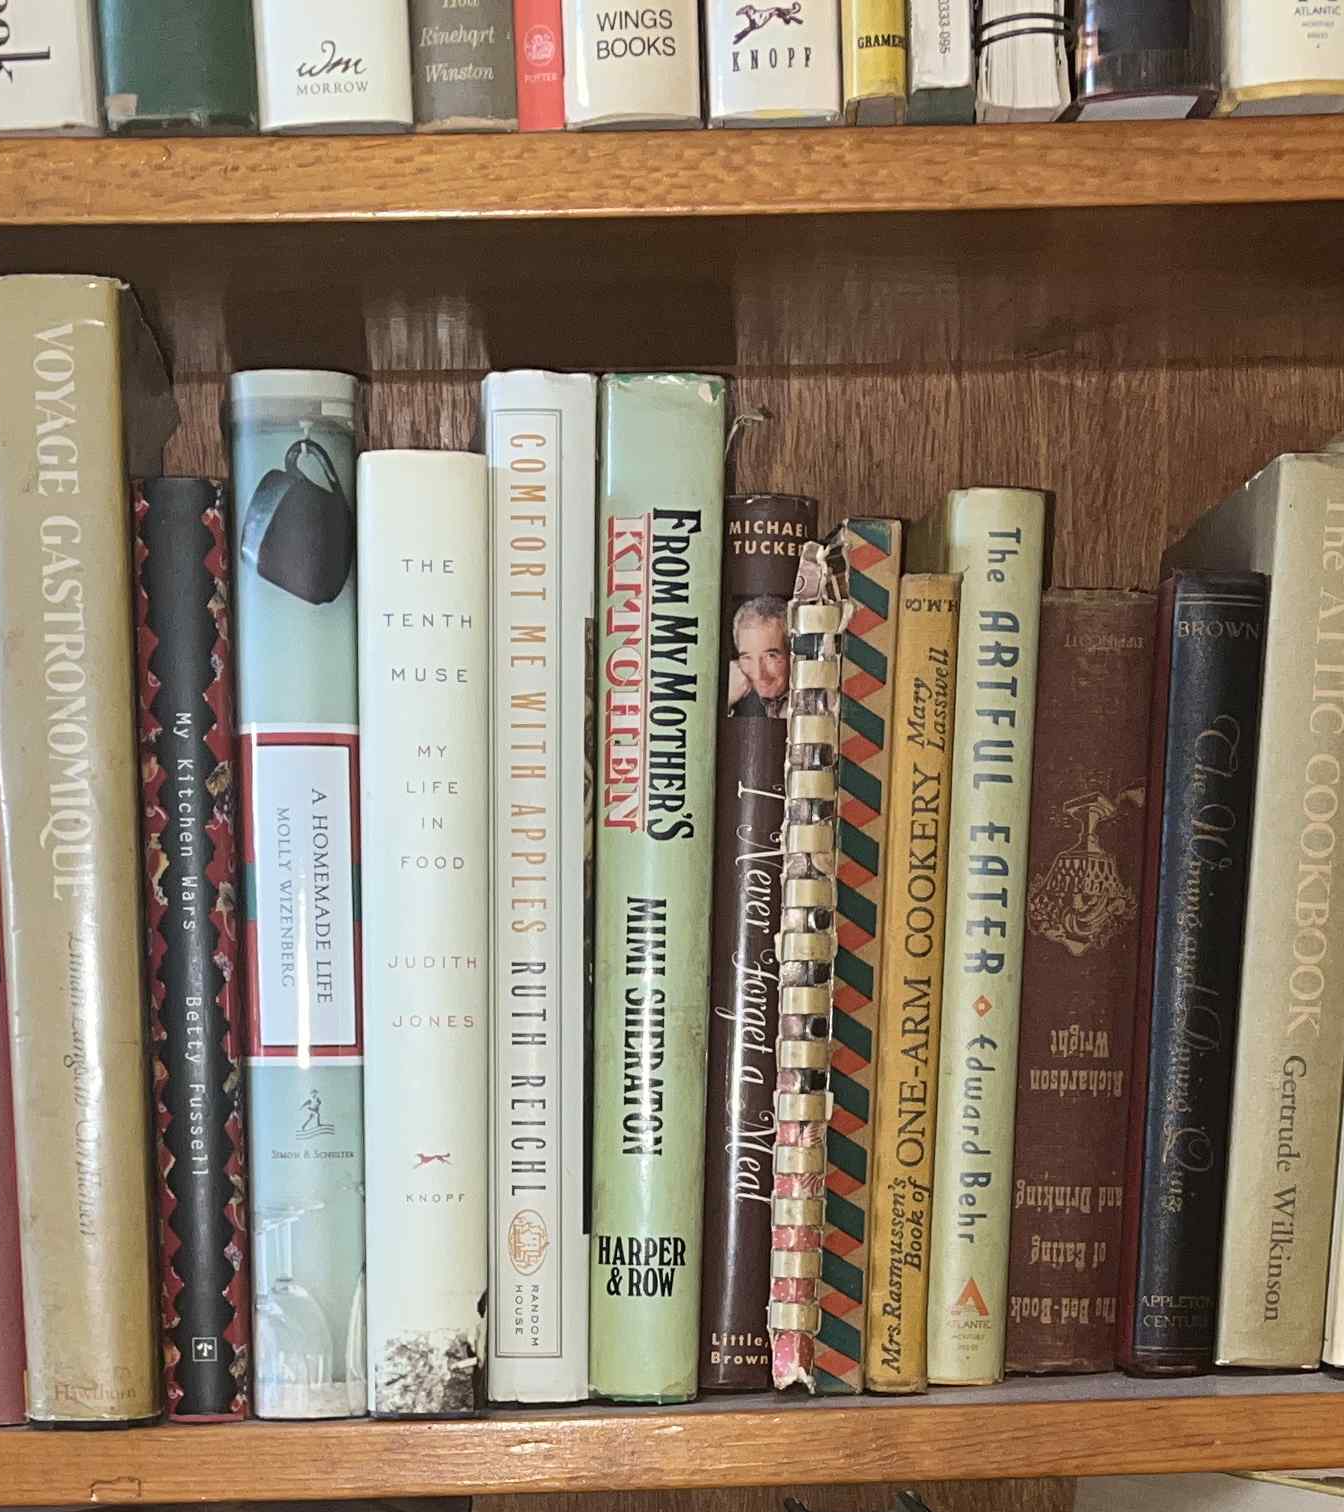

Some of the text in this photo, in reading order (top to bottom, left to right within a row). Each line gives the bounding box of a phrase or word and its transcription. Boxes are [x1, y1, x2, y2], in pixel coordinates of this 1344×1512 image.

[598, 10, 674, 32] WINGS
[419, 26, 496, 48] Rinehart
[596, 36, 677, 60] BOOKS
[731, 46, 813, 73] KNOPF
[424, 61, 496, 84] Winston
[296, 80, 369, 97] MORROW
[401, 558, 455, 574] THE
[382, 612, 473, 631] TENTH
[391, 667, 470, 684] MUSE
[645, 506, 703, 842] FROM MY MOTHER'S
[964, 527, 1023, 977] The ARTFUL EATER
[173, 711, 201, 932] My Kitchen Wars
[508, 432, 549, 1199] COMFORT ME WITH APPLES RUTH REICHL
[387, 954, 478, 971] JUDITH
[896, 761, 943, 1169] ONE-ARM COOKERY
[392, 1014, 475, 1030] JONES
[955, 1033, 999, 1244] Edward Behr
[405, 1192, 467, 1204] KNOPF
[597, 1235, 688, 1266] HARPER
[605, 1267, 676, 1297] & ROW
[710, 1333, 770, 1351] Little,
[710, 1350, 769, 1366] Brown
